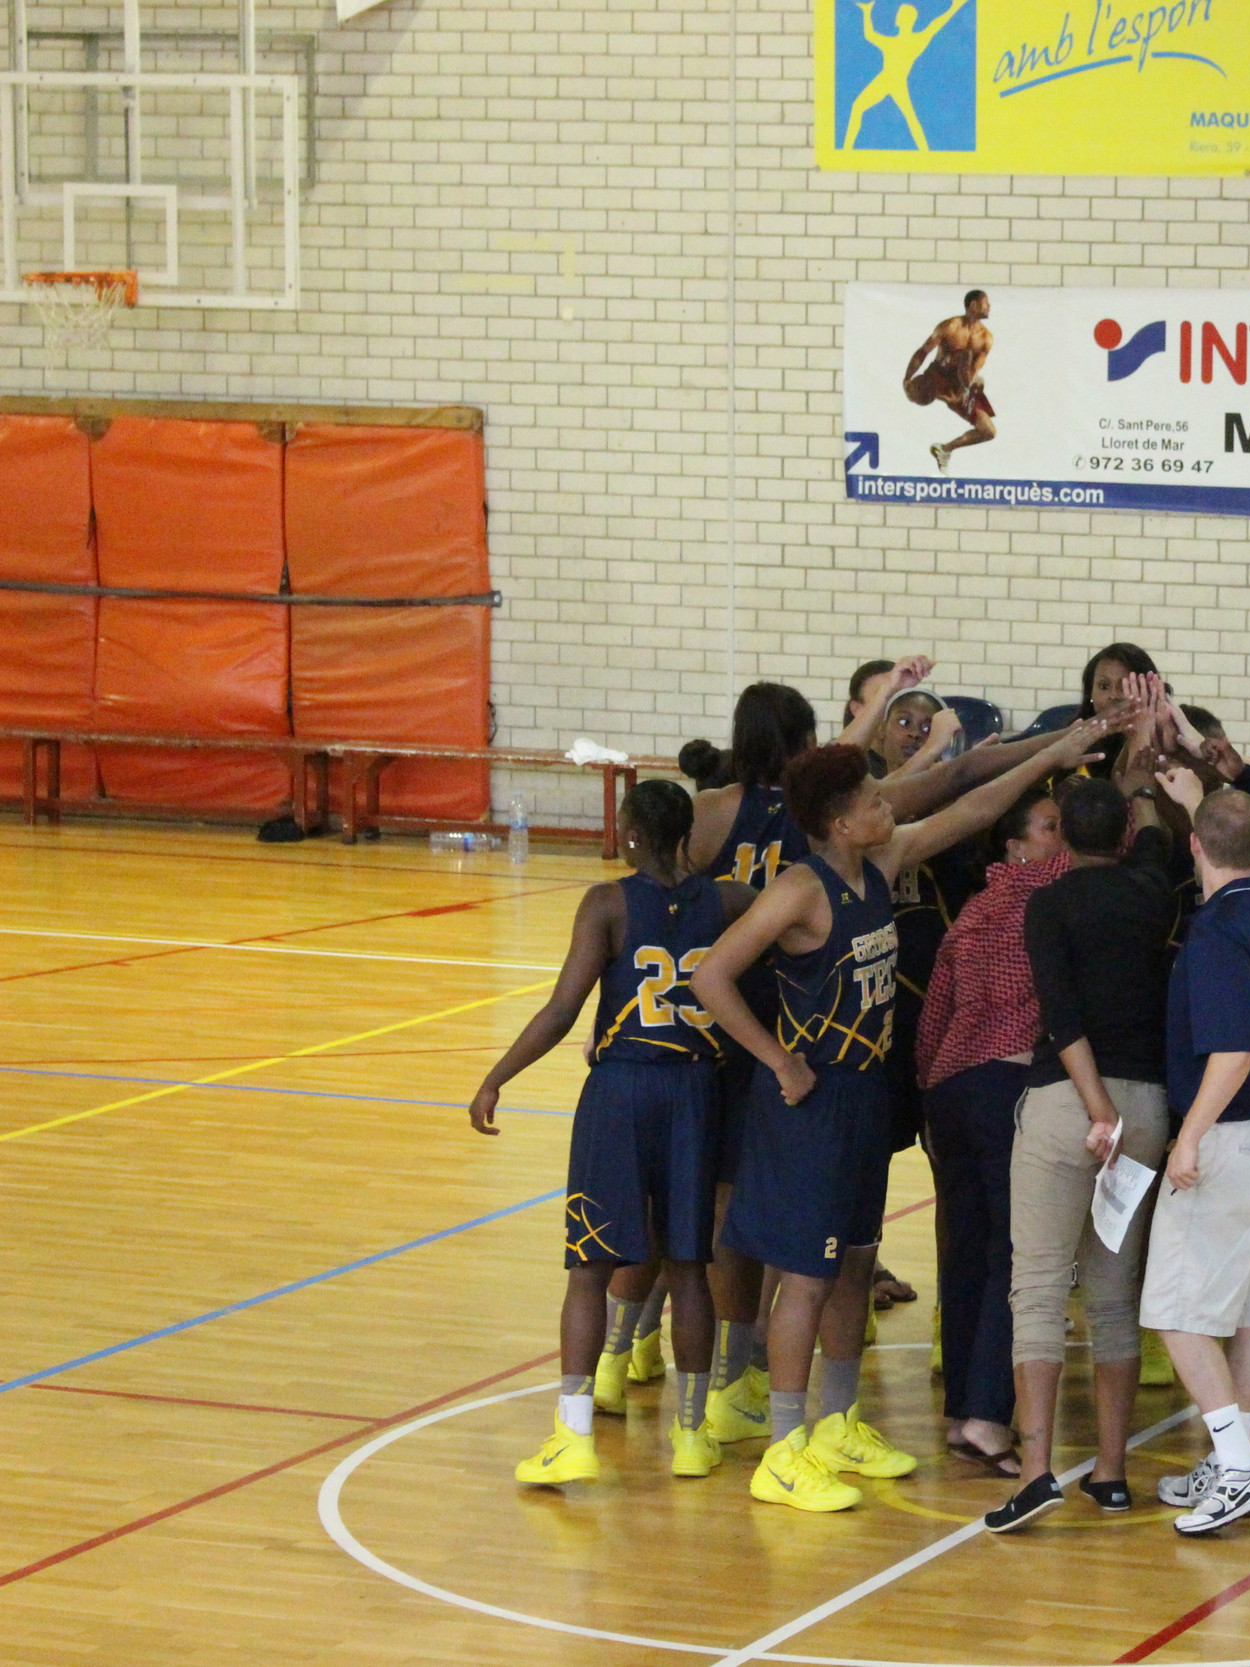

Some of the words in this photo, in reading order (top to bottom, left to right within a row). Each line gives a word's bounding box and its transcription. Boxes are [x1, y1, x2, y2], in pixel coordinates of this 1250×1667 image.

[993, 12, 1074, 83] amb
[1101, 436, 1140, 451] Lloret
[1144, 438, 1157, 451] de
[1161, 438, 1185, 452] Mar
[1089, 455, 1125, 471] 972
[1131, 457, 1155, 472] 36
[1161, 458, 1185, 473] 69
[1191, 459, 1215, 474] 47
[852, 952, 898, 1011] TEC
[823, 1236, 838, 1259] 2
